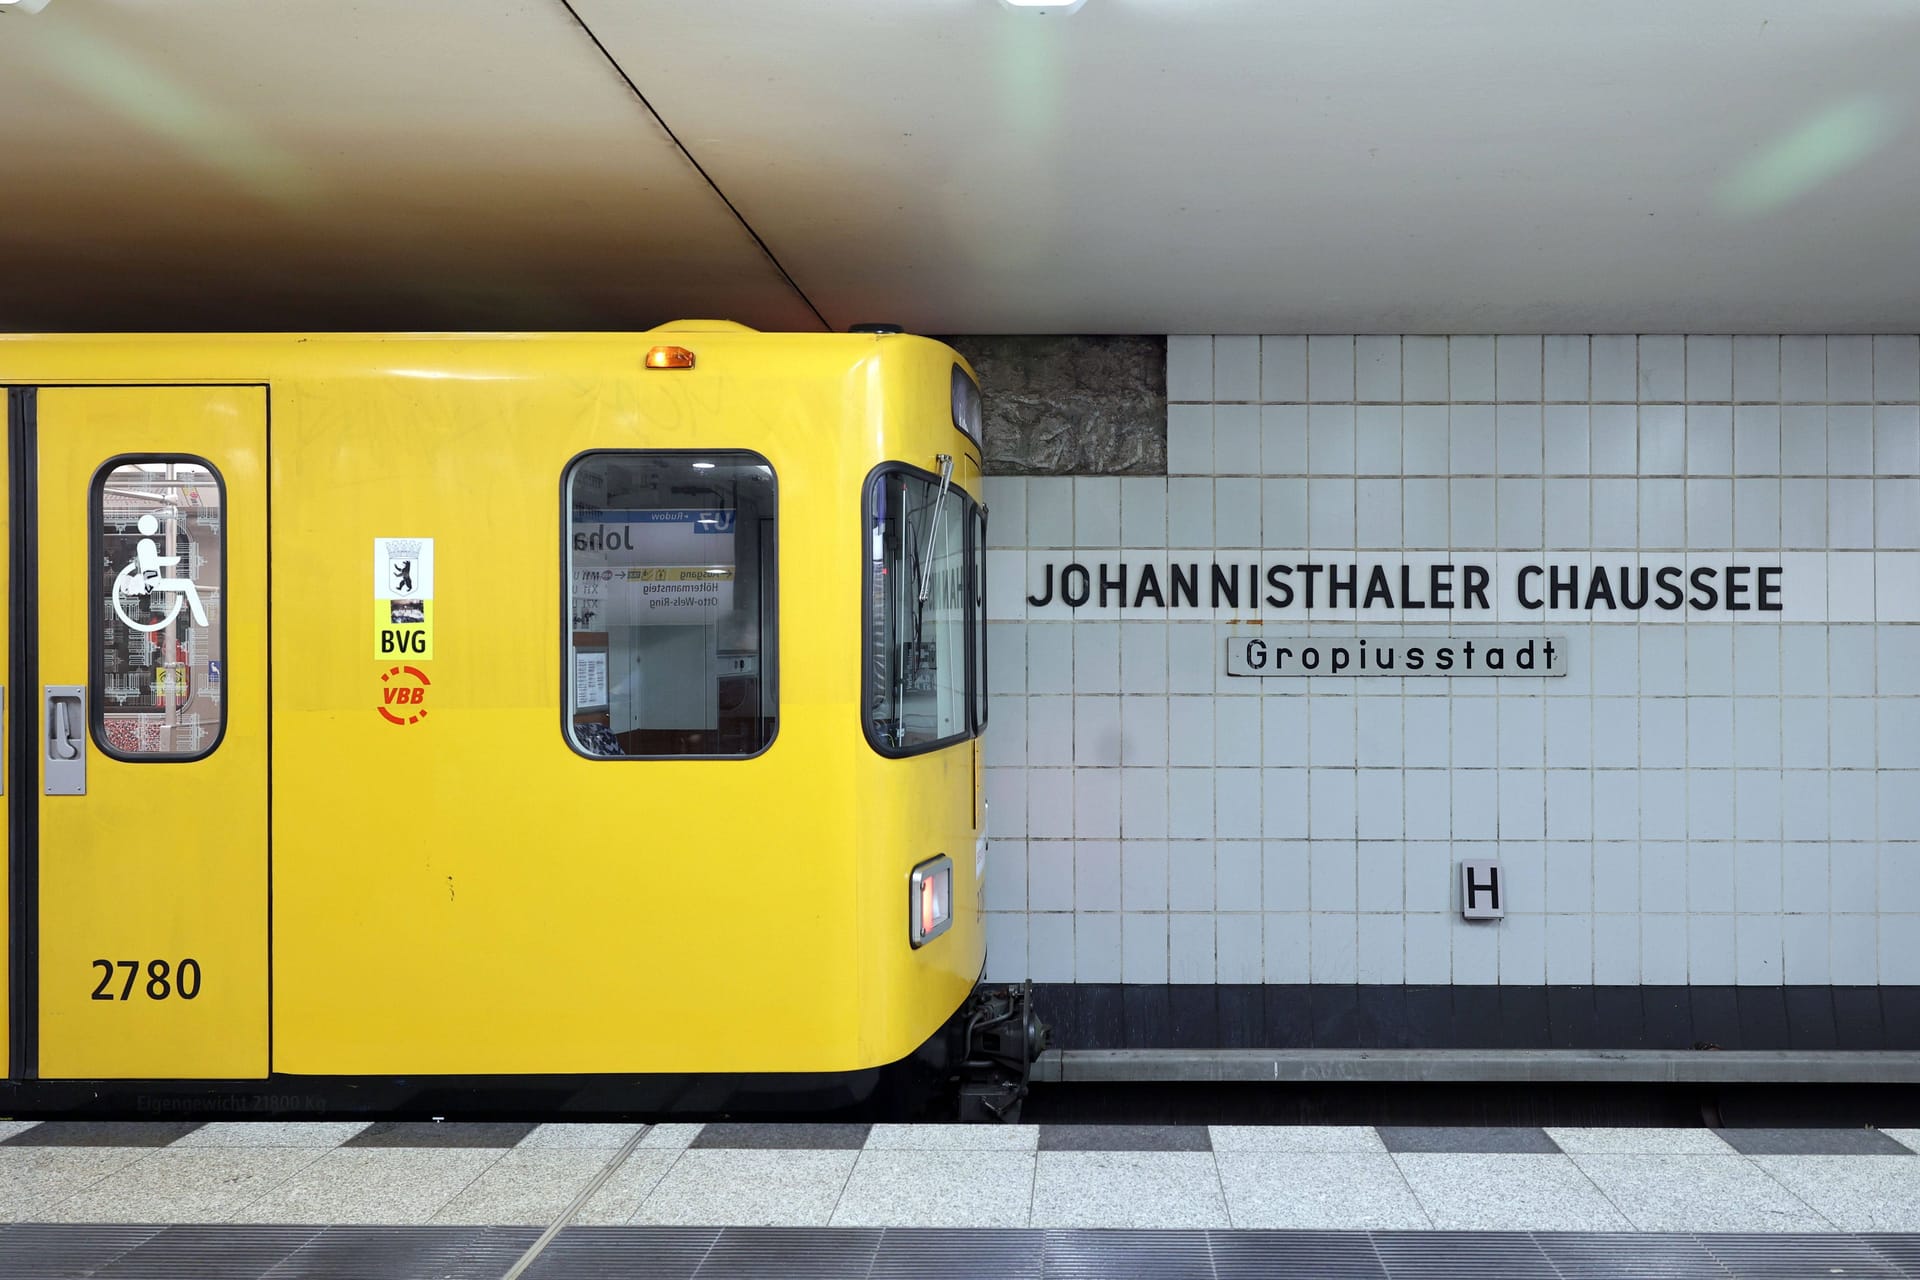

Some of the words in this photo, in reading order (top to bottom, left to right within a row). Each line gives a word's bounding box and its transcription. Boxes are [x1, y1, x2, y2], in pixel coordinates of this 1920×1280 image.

[1027, 563, 1490, 609] JOHANNISTHALER
[1517, 565, 1784, 611] CHAUSSEE
[381, 630, 426, 653] BVG
[1246, 639, 1555, 673] Gropiusstadt
[383, 687, 426, 705] VBB
[1467, 867, 1499, 909] H
[91, 958, 201, 1001] 2780
[137, 1095, 248, 1113] Eigengewicht
